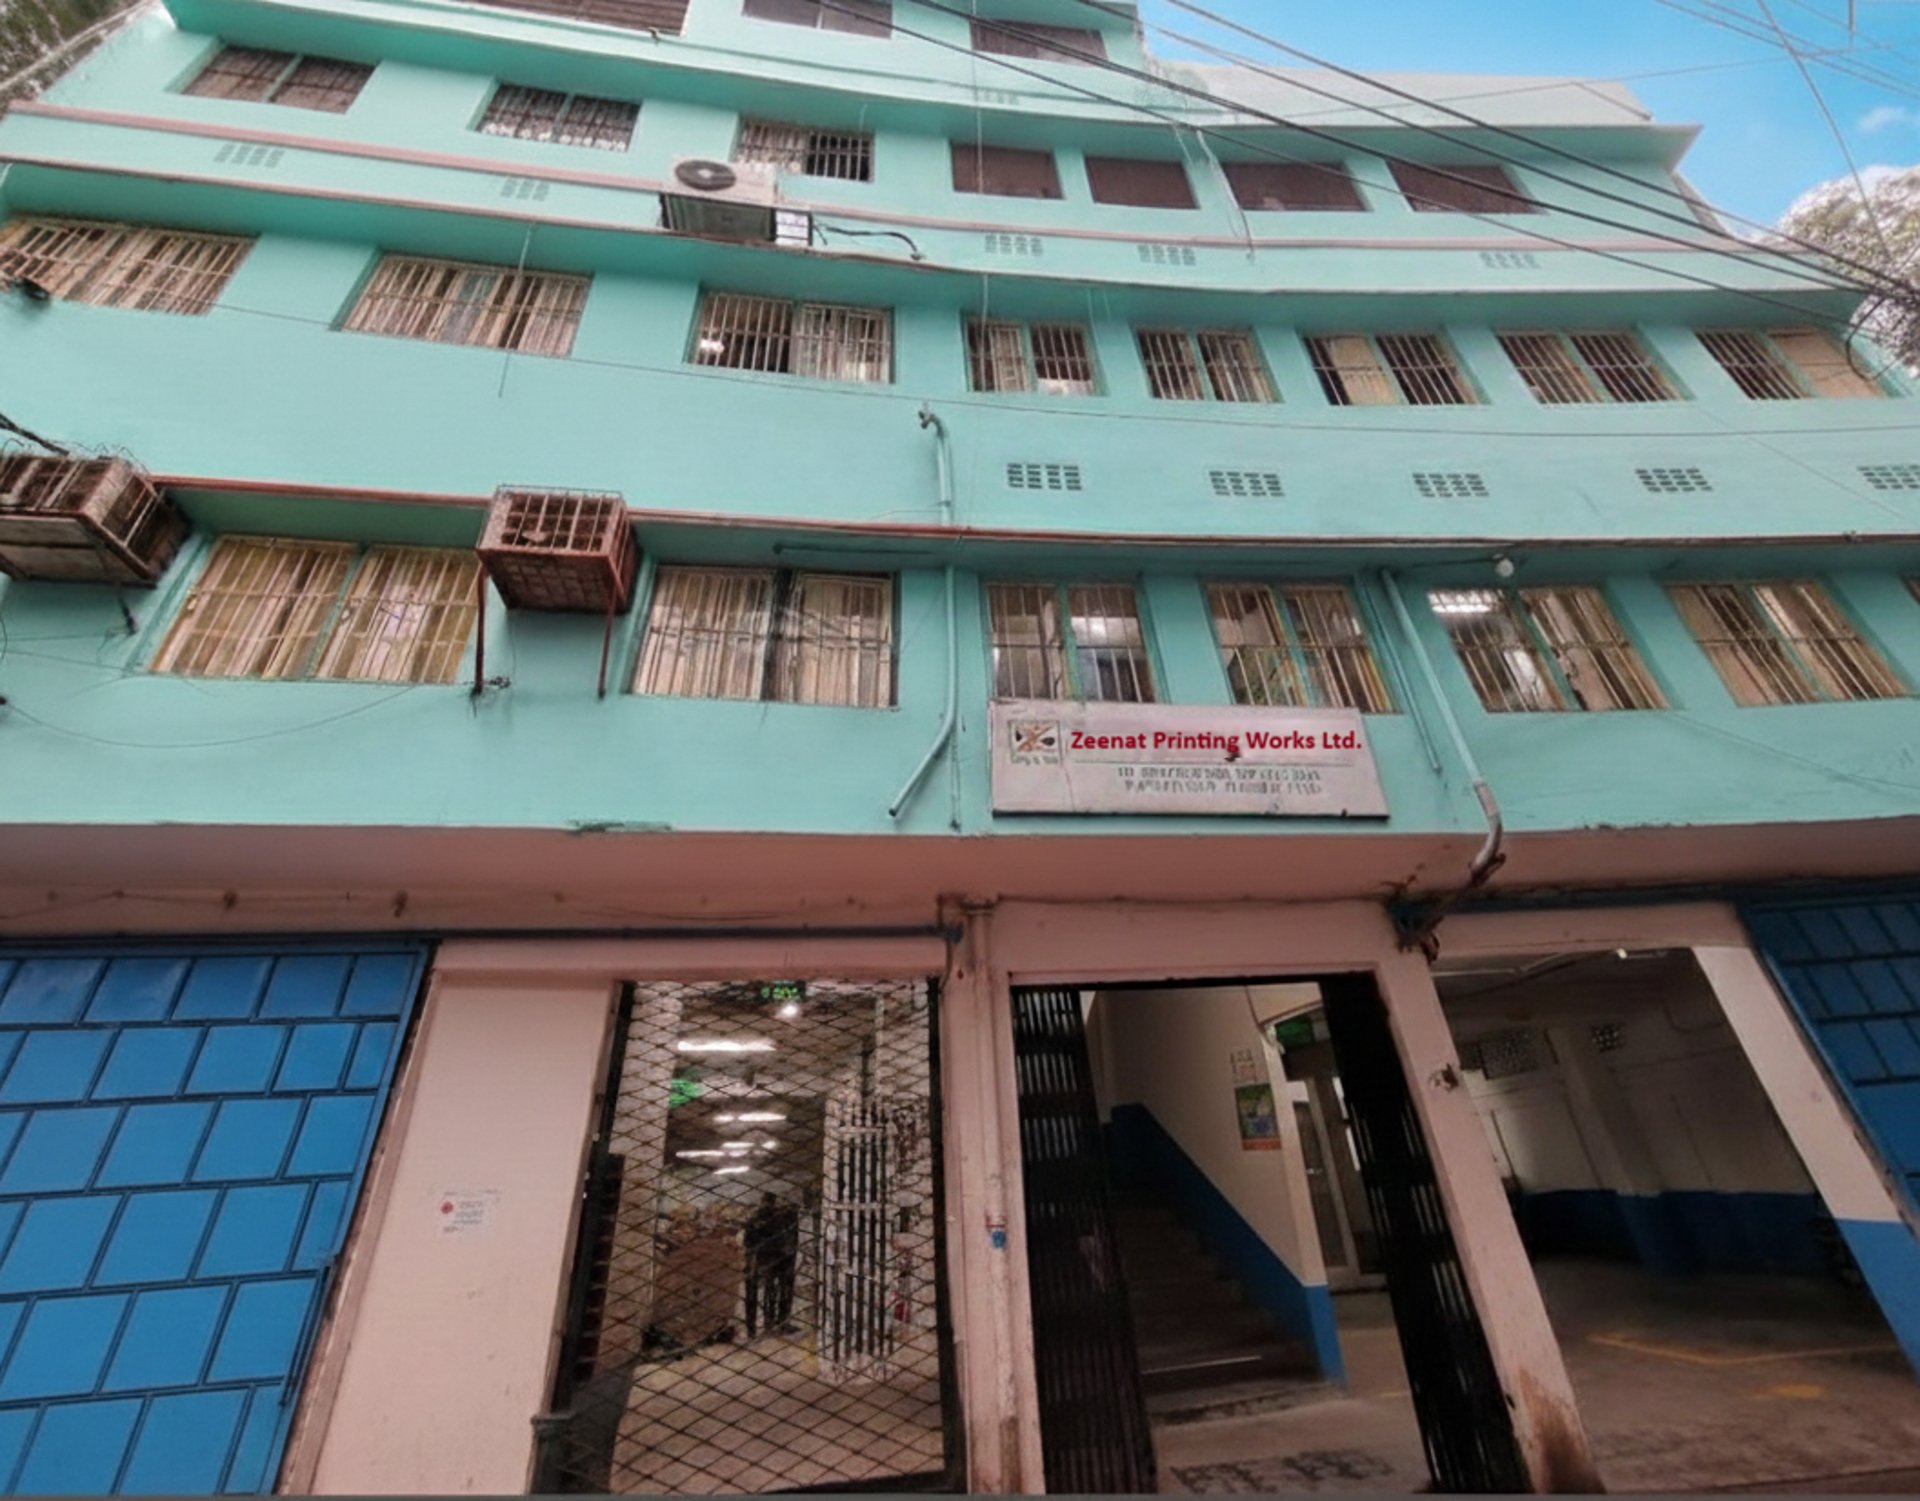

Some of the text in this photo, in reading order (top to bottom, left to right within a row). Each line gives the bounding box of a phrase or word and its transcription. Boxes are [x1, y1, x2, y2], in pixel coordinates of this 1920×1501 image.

[1071, 731, 1361, 754] Zeenat Printing Works Ltd.
